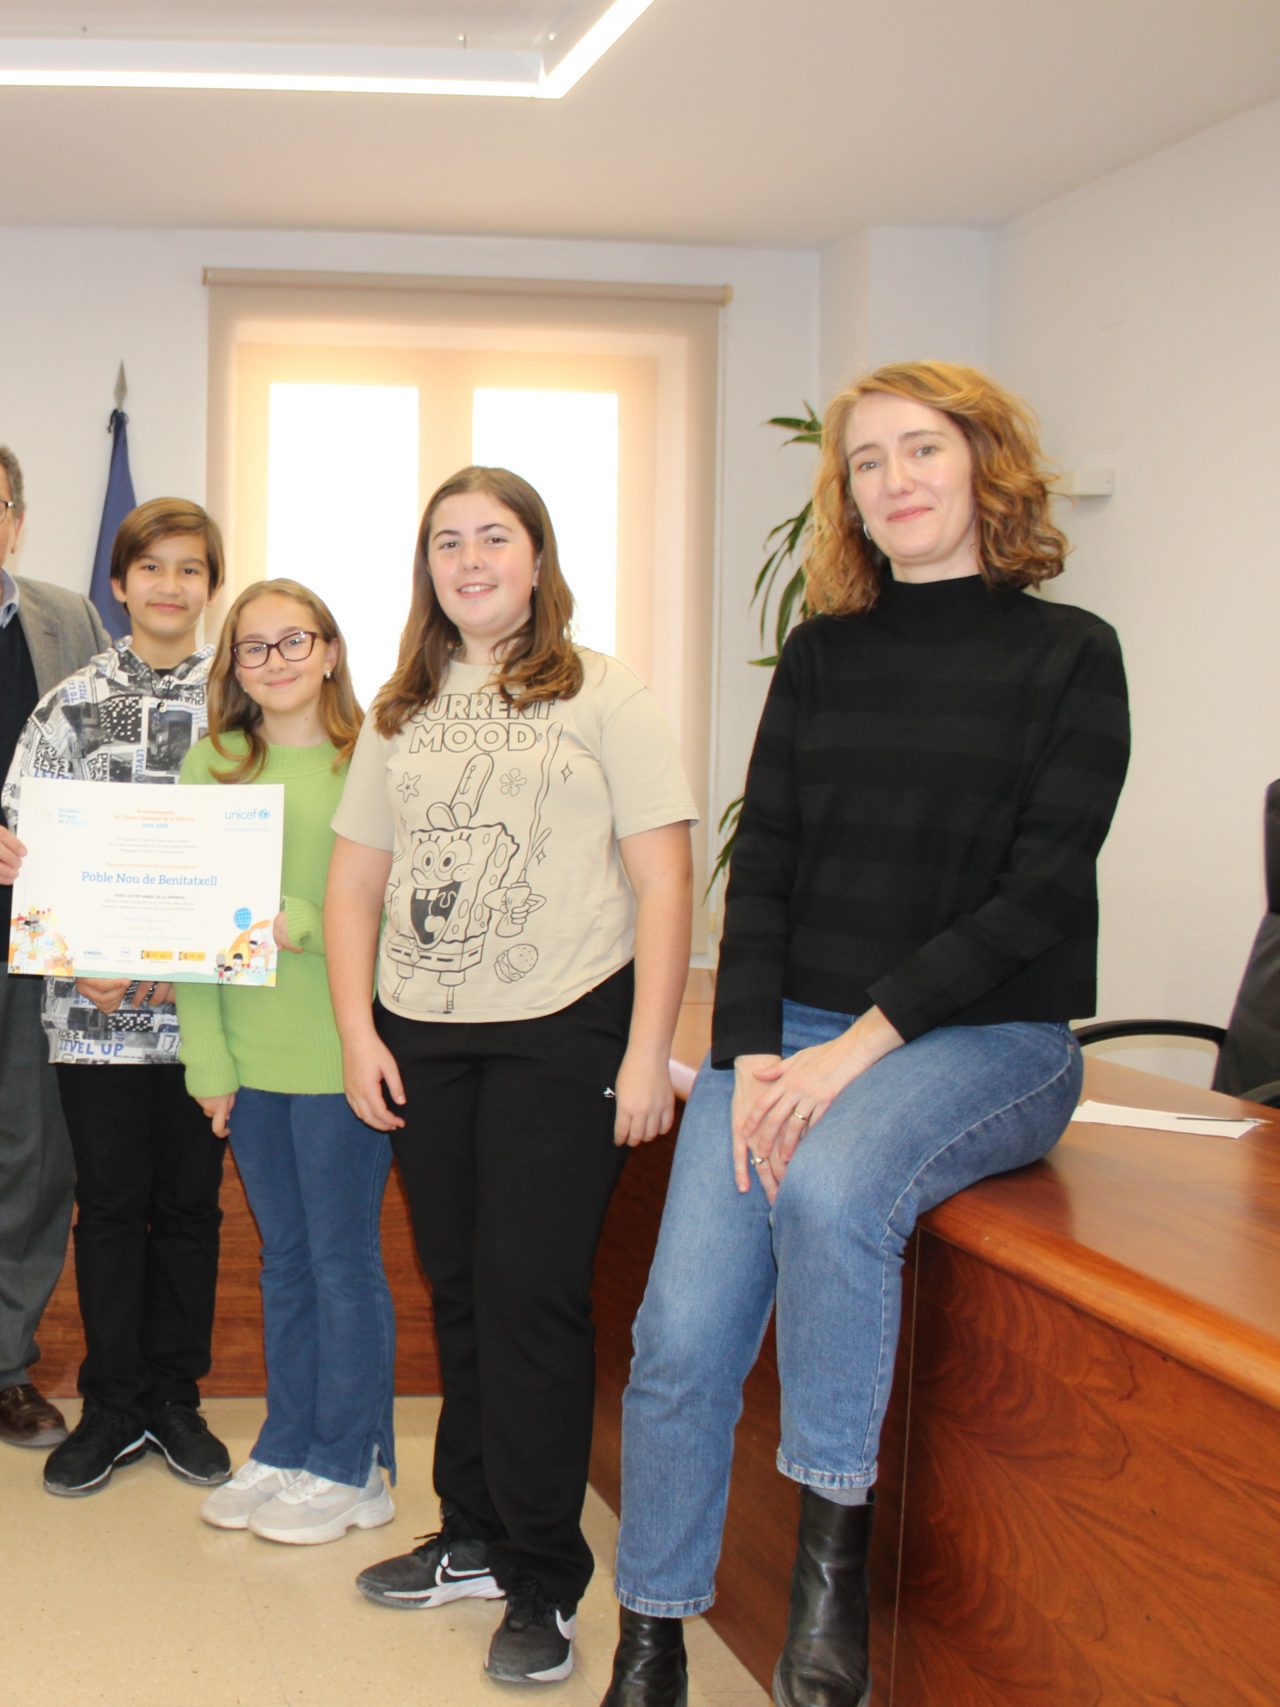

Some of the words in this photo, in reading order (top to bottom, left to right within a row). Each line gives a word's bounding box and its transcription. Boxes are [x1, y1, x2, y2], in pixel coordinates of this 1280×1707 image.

[409, 722, 536, 753] MOOD
[224, 809, 258, 820] unicef
[81, 871, 114, 883] Poble
[116, 873, 140, 885] Nou
[142, 873, 156, 885] de
[158, 874, 218, 886] Benitatxell
[101, 1043, 124, 1057] UP
